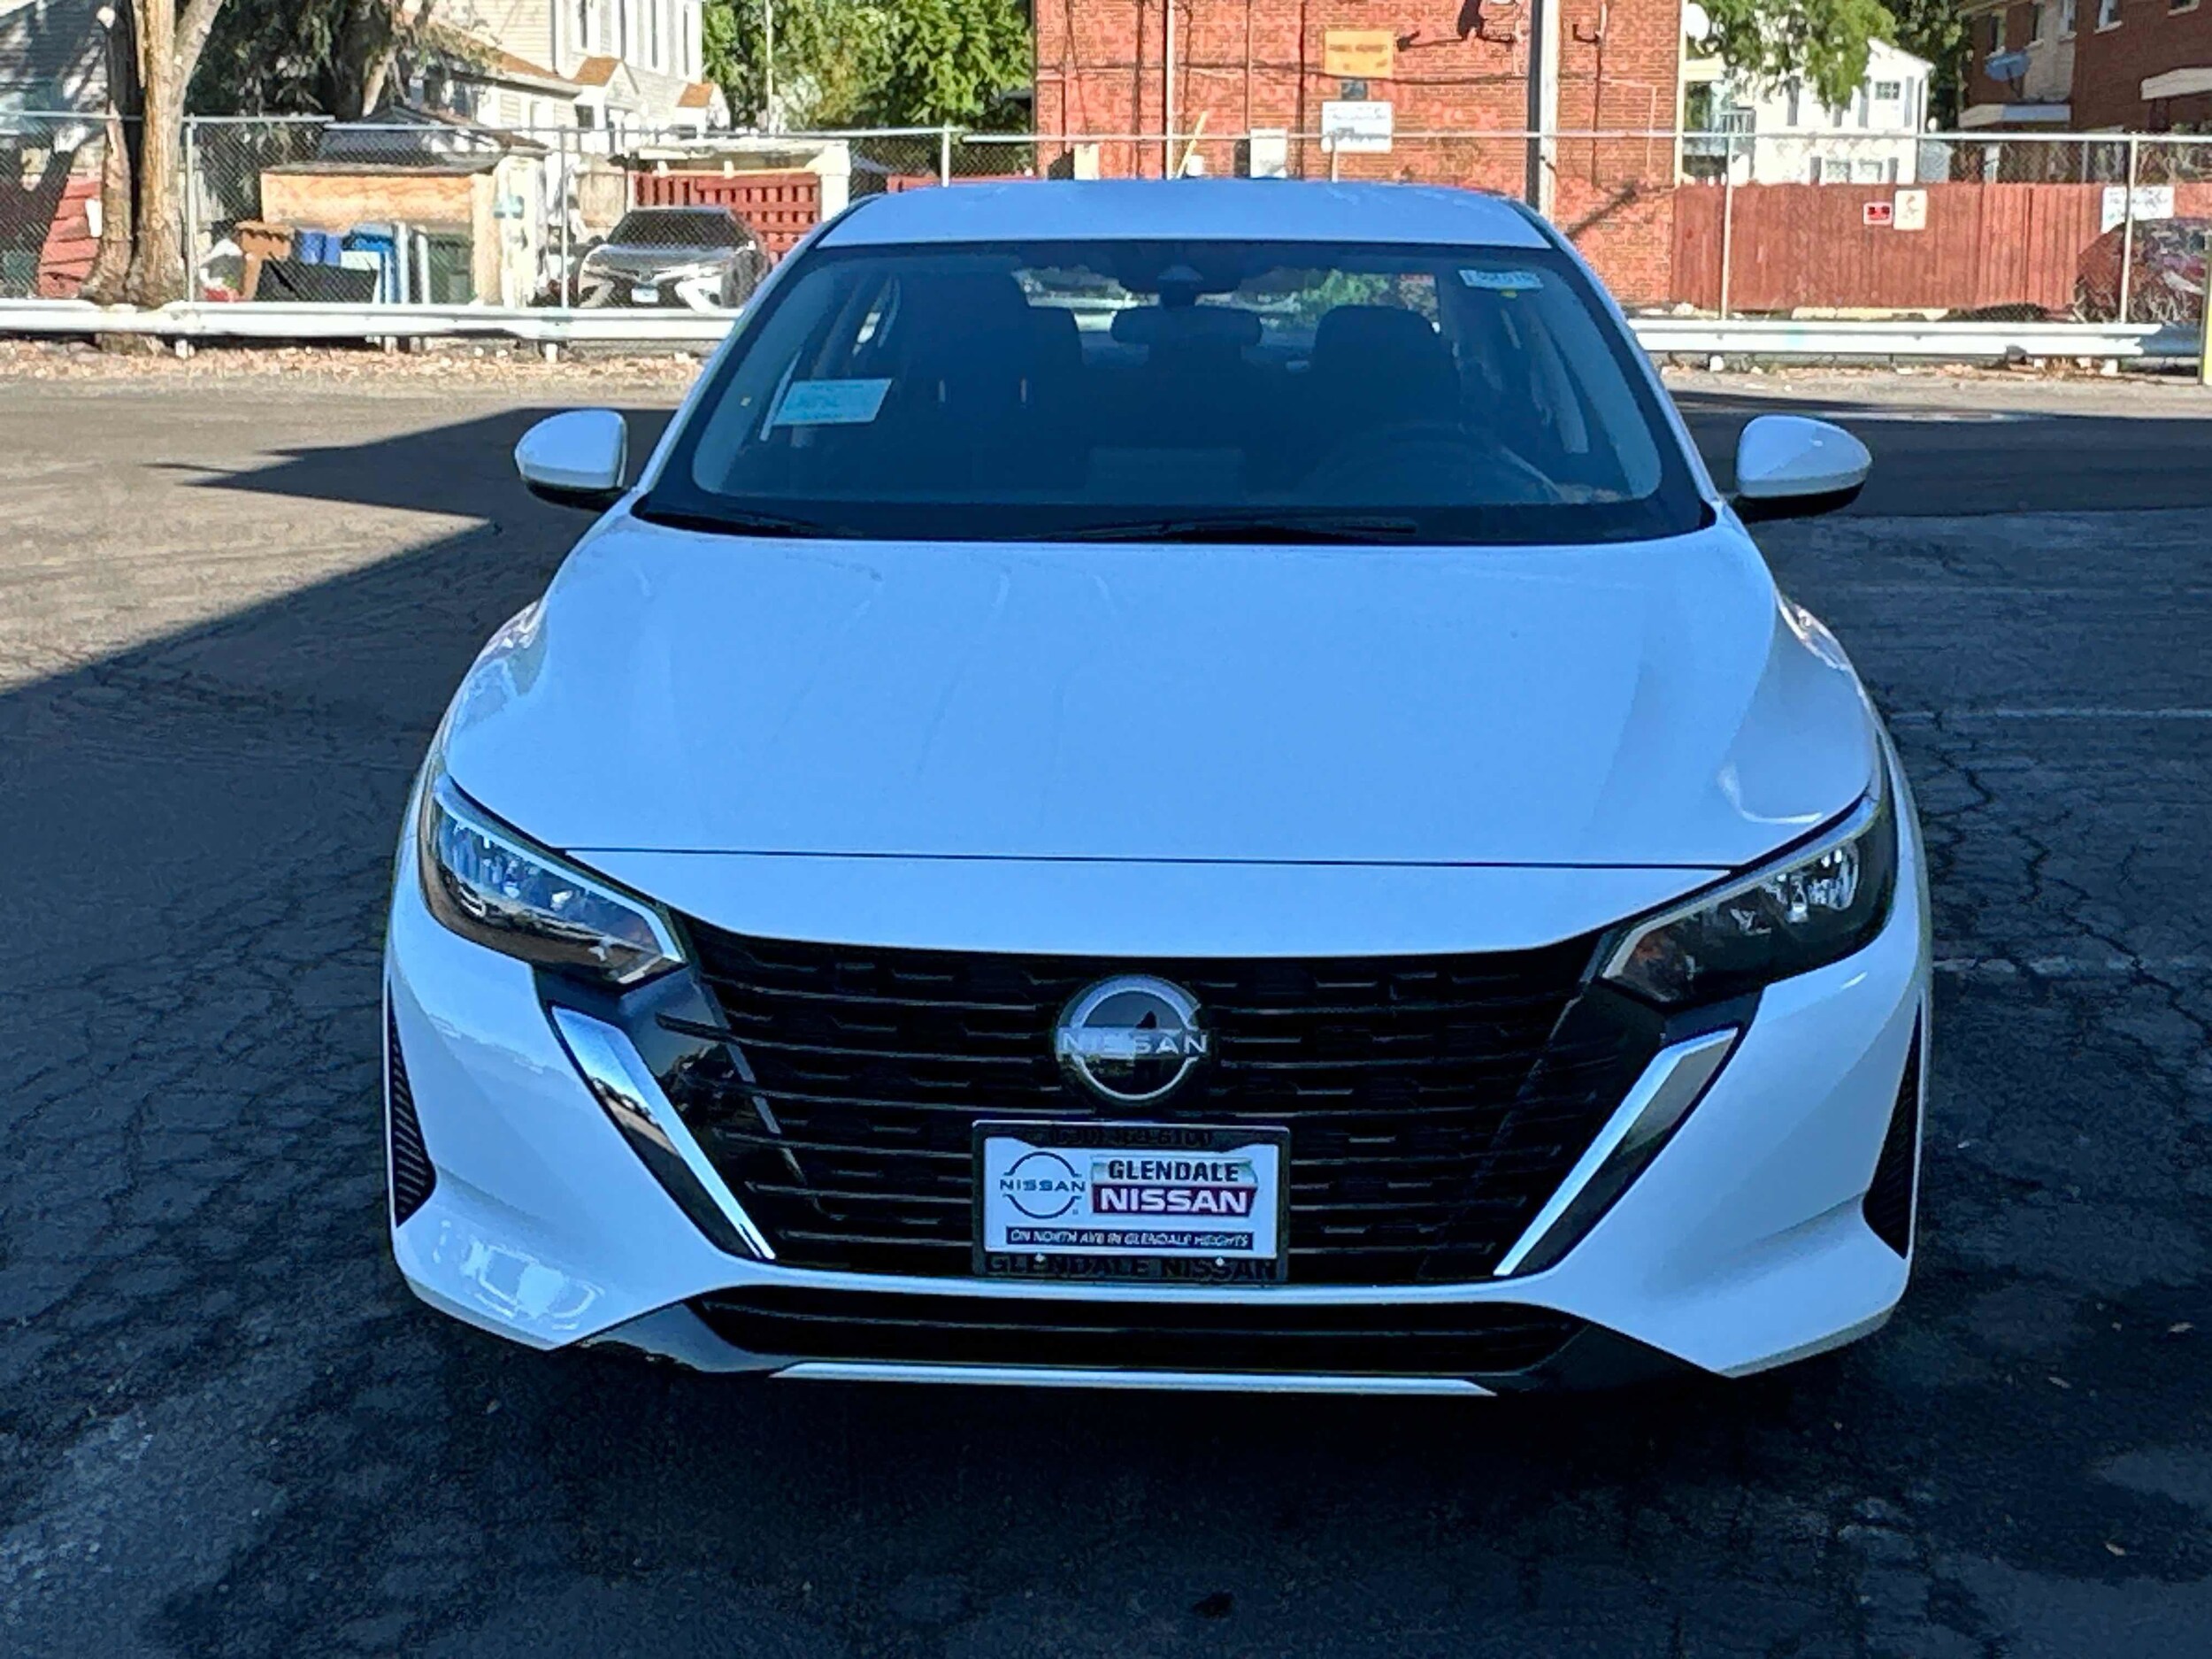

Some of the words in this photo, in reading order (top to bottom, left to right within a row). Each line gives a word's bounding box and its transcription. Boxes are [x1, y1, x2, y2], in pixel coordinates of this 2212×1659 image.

[1062, 1033, 1208, 1055] NISSAN
[1108, 1159, 1239, 1182] GLENDALE
[999, 1179, 1086, 1193] NISSAN
[1100, 1187, 1247, 1214] NISSAN
[1010, 1228, 1032, 1242] ON
[1160, 1258, 1277, 1280] NISSAN
